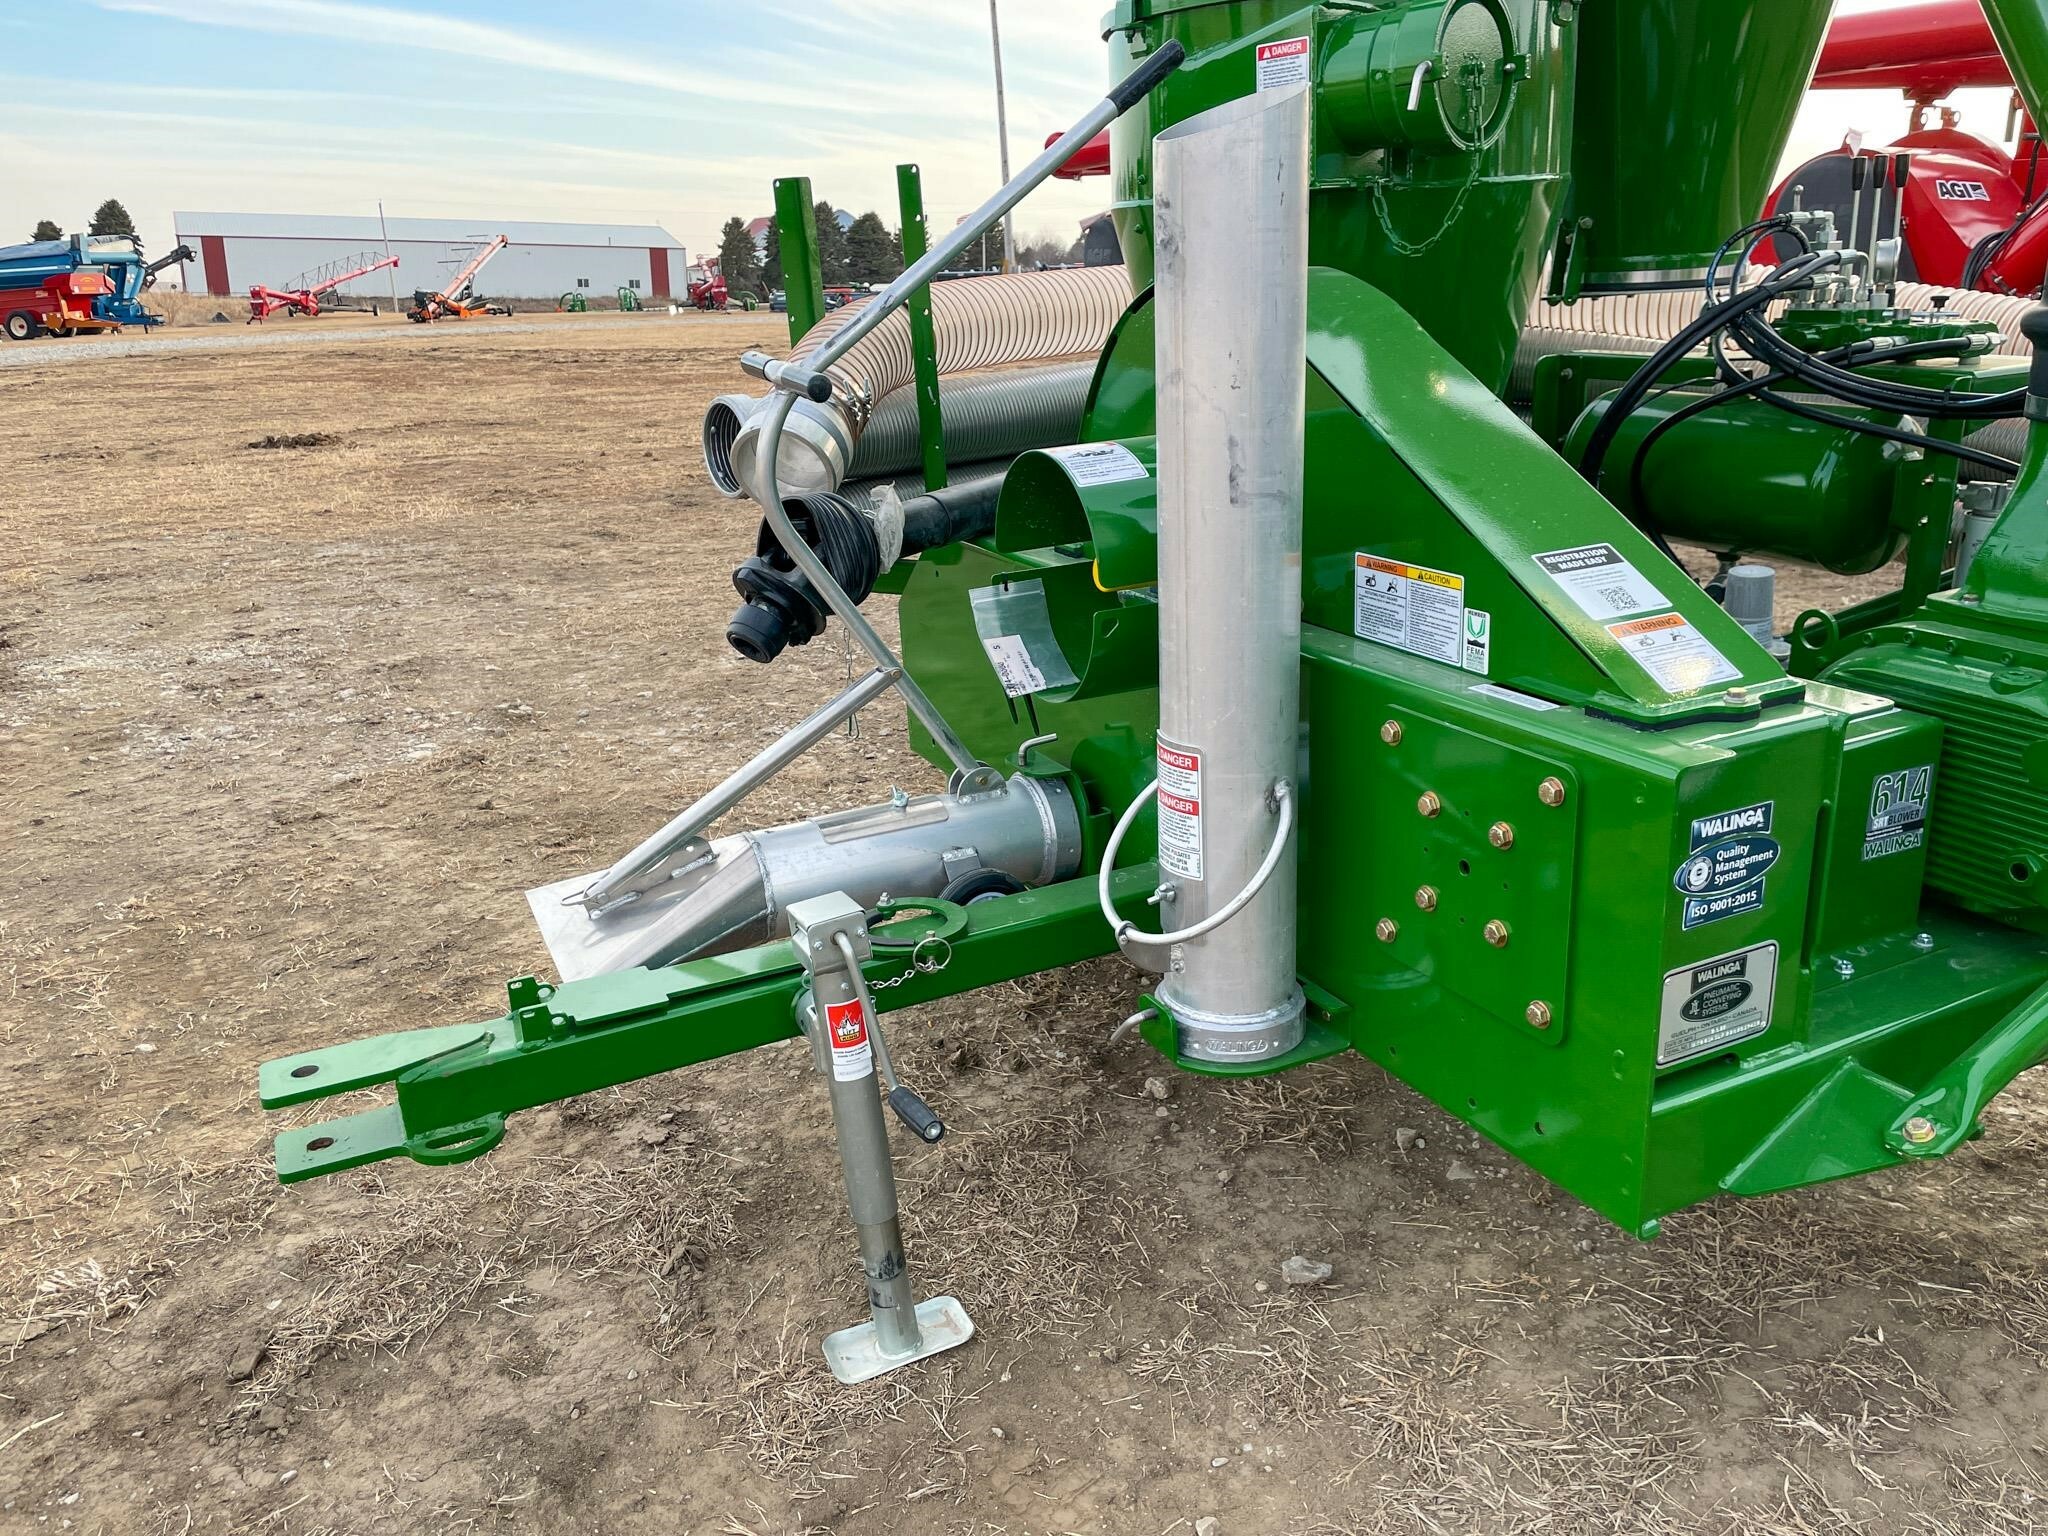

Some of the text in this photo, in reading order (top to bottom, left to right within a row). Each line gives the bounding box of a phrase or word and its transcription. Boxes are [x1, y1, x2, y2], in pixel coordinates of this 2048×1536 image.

[1271, 42, 1302, 56] DANGER
[1938, 182, 1972, 199] AGI
[1543, 548, 1609, 564] REGISTRATION
[1557, 555, 1608, 570] MADE EASY
[1372, 560, 1398, 573] WARNING
[1424, 573, 1451, 585] CAUTION
[1631, 617, 1678, 632] WARNING
[1466, 646, 1485, 657] FEMA
[1160, 750, 1193, 769] DANGER
[1871, 766, 1930, 820] 614
[1160, 794, 1194, 813] DANGER
[1700, 808, 1765, 838] WALINGA
[1716, 844, 1750, 860] Quality
[1863, 833, 1921, 860] WALINGA
[1715, 849, 1774, 874] Management
[1714, 869, 1747, 886] System
[1691, 890, 1757, 918] ISO 9001:2015
[1697, 961, 1741, 983] WALINGA
[1702, 990, 1742, 1008] CONVEYING
[1703, 983, 1740, 1000] PNEUMATIC
[1702, 1002, 1729, 1017] SYSTEMS
[1671, 1026, 1697, 1038] GUELPH
[1700, 1016, 1728, 1029] ONTARIO
[1732, 1006, 1758, 1019] CANADA
[1208, 1039, 1264, 1052] WALINGA
